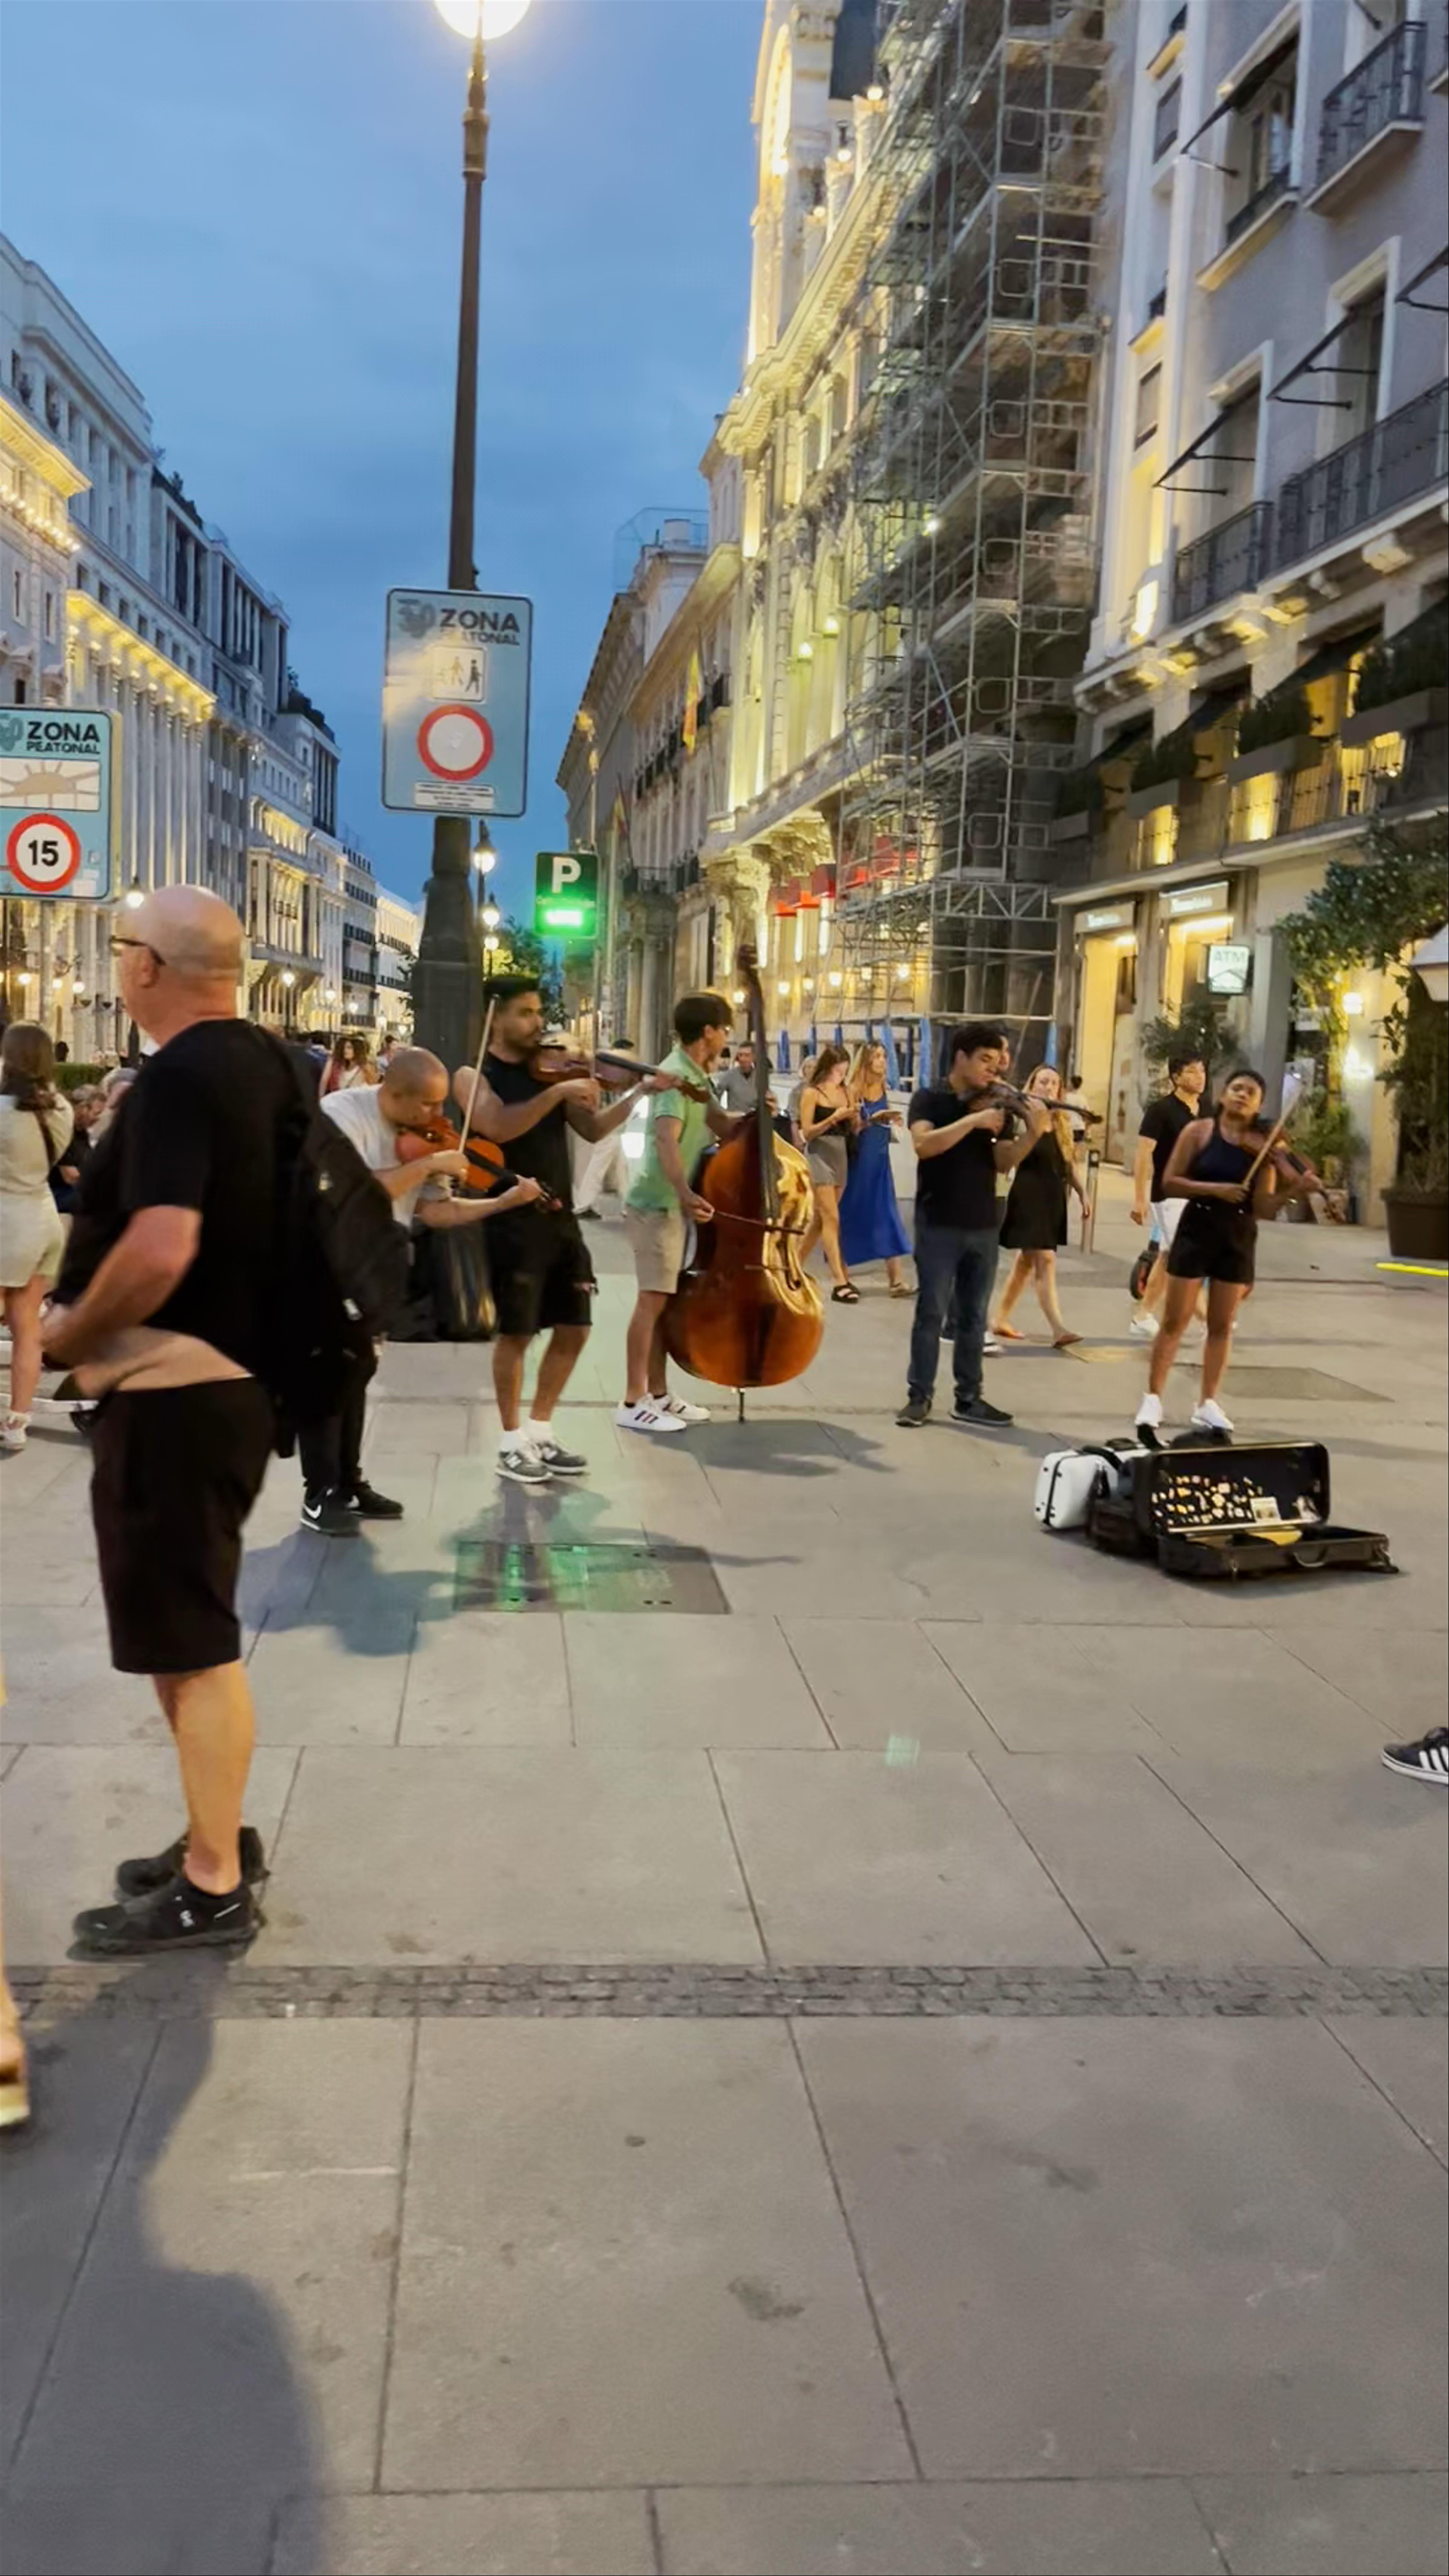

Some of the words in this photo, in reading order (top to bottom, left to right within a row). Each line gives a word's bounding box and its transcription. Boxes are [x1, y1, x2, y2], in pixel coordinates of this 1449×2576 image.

[439, 608, 520, 633] ZONA
[440, 627, 520, 646] TONAL
[28, 721, 100, 743] ZONA
[27, 741, 100, 754] PEATONAL
[28, 840, 58, 867] 15
[552, 857, 581, 893] P
[1214, 951, 1246, 963] ATM
